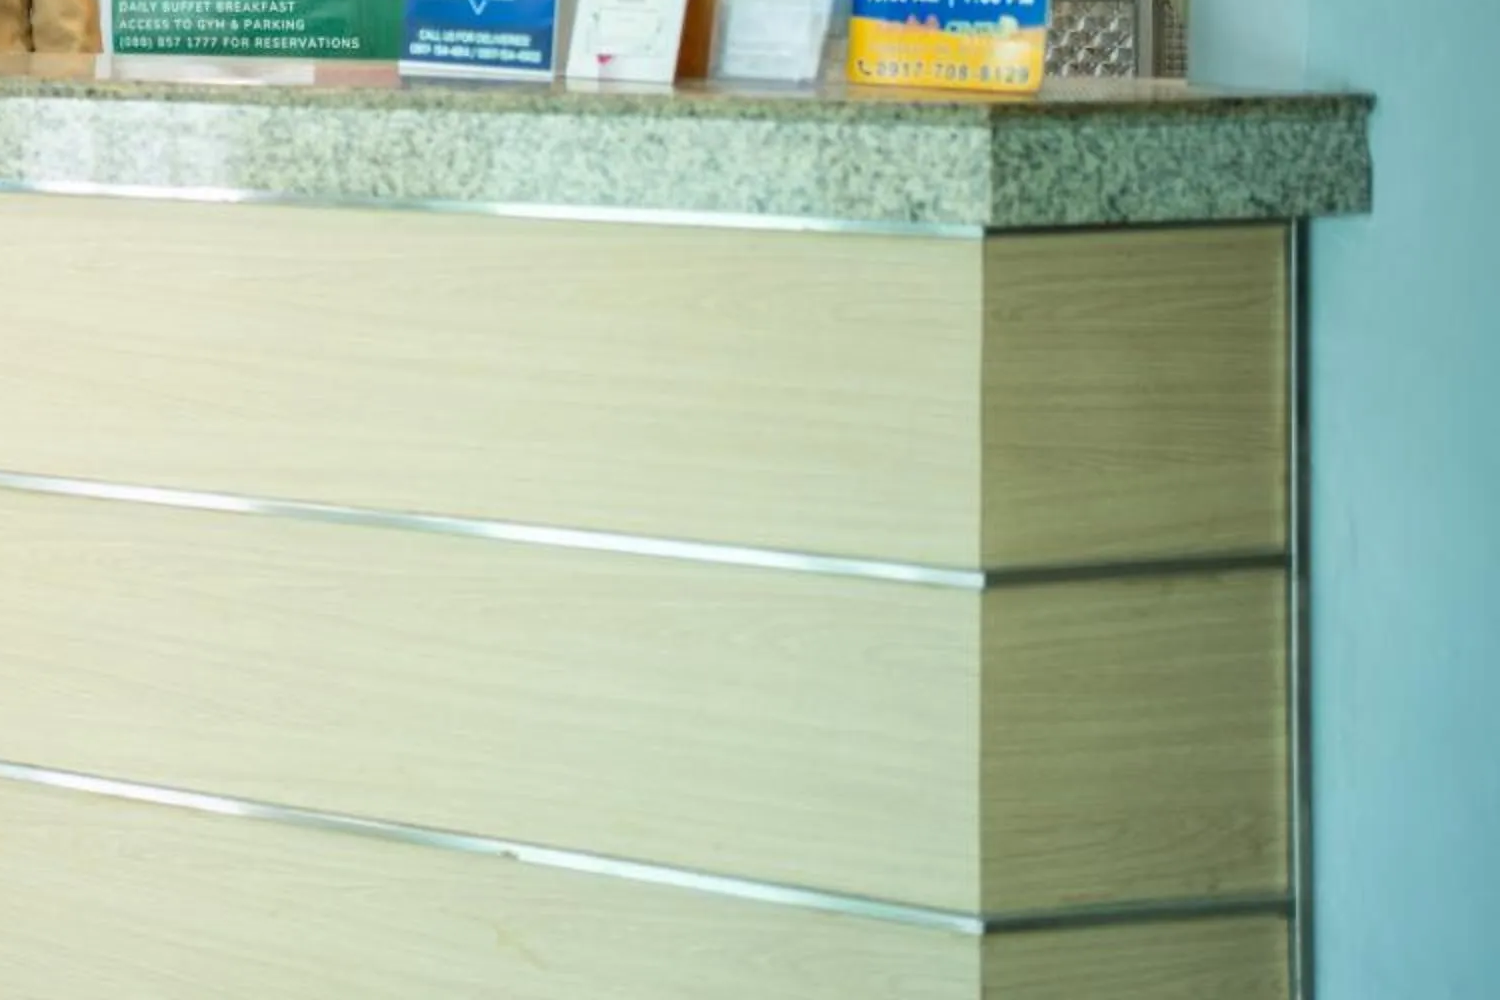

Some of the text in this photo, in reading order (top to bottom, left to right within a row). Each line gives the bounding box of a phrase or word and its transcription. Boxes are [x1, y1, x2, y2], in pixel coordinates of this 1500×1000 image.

[118, 0, 296, 13] DAILY BUFFET BREAKFAST
[119, 19, 305, 31] ACCESS TO GYM & PARKING
[187, 36, 218, 49] 1777
[222, 36, 249, 49] FOR
[254, 36, 360, 49] RESERVATIONS
